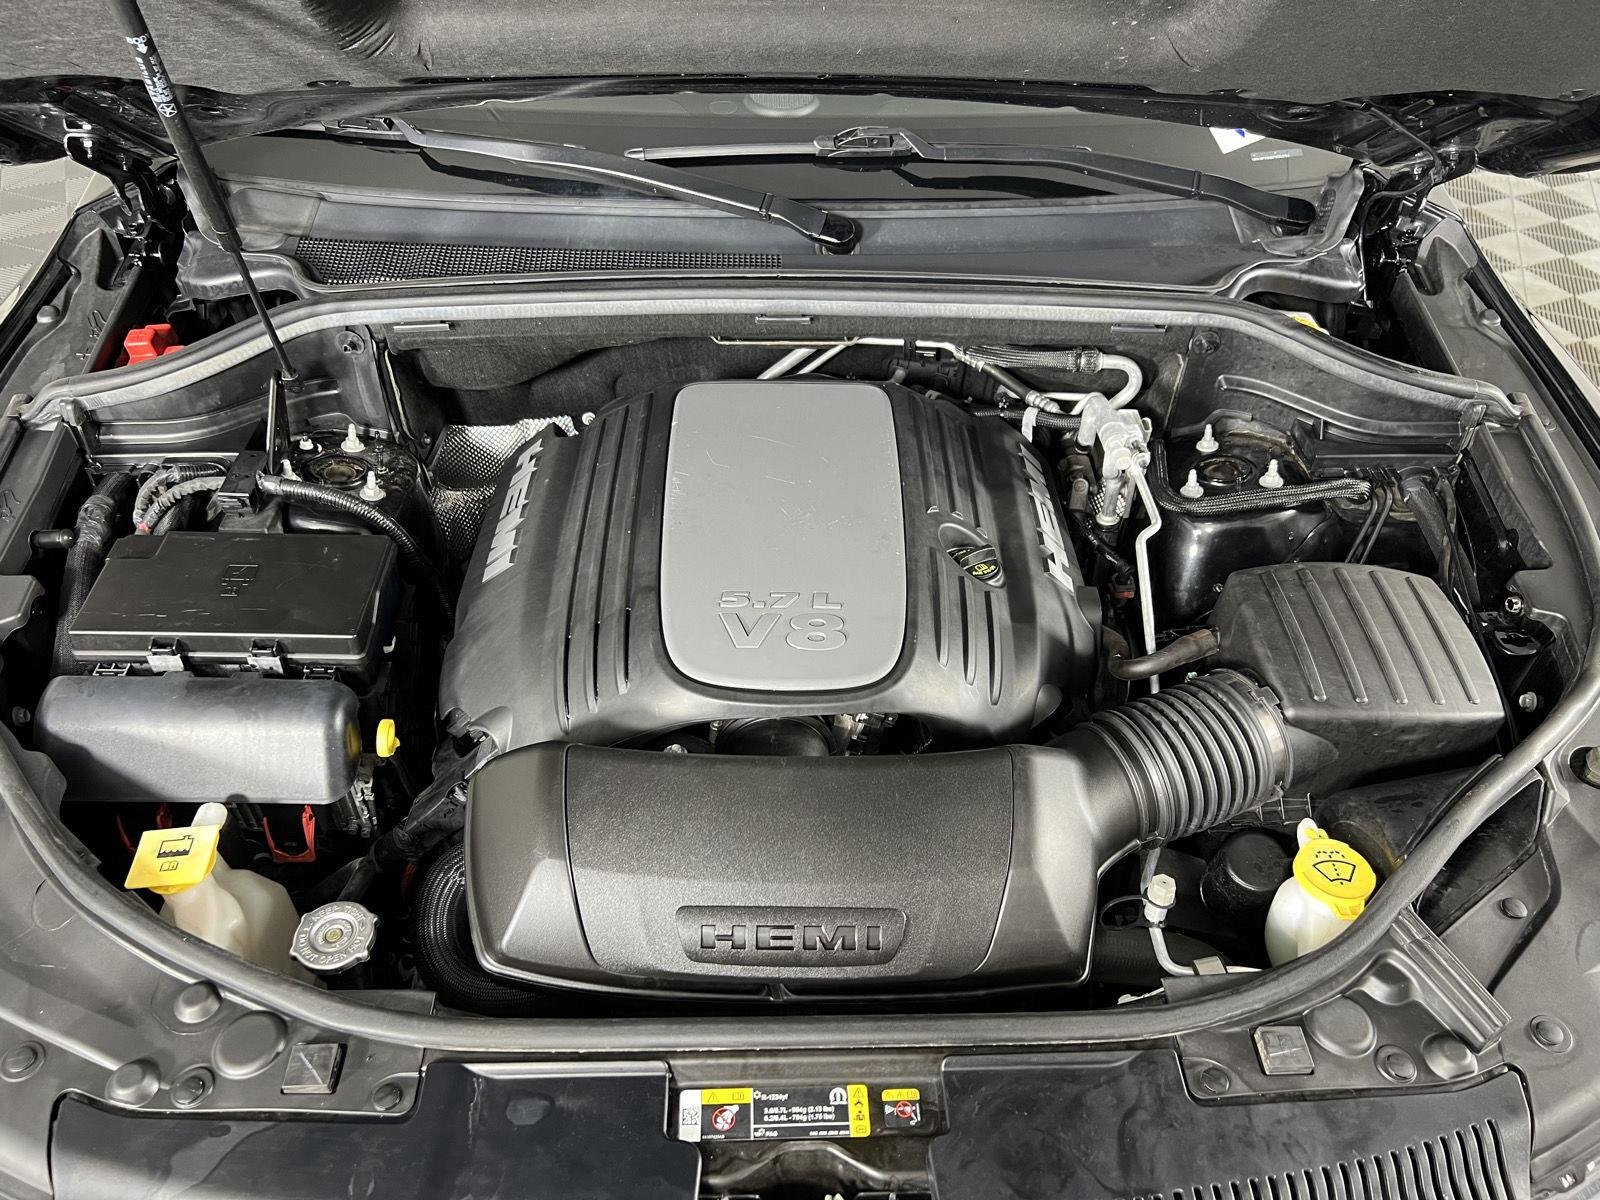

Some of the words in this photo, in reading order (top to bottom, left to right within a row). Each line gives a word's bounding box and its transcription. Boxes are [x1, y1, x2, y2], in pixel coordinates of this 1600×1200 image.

[481, 438, 544, 584] HEMI
[1018, 443, 1075, 597] HEMI
[719, 590, 800, 609] 5.7
[811, 591, 843, 610] L
[717, 612, 848, 651] V8
[700, 924, 882, 951] HEMI
